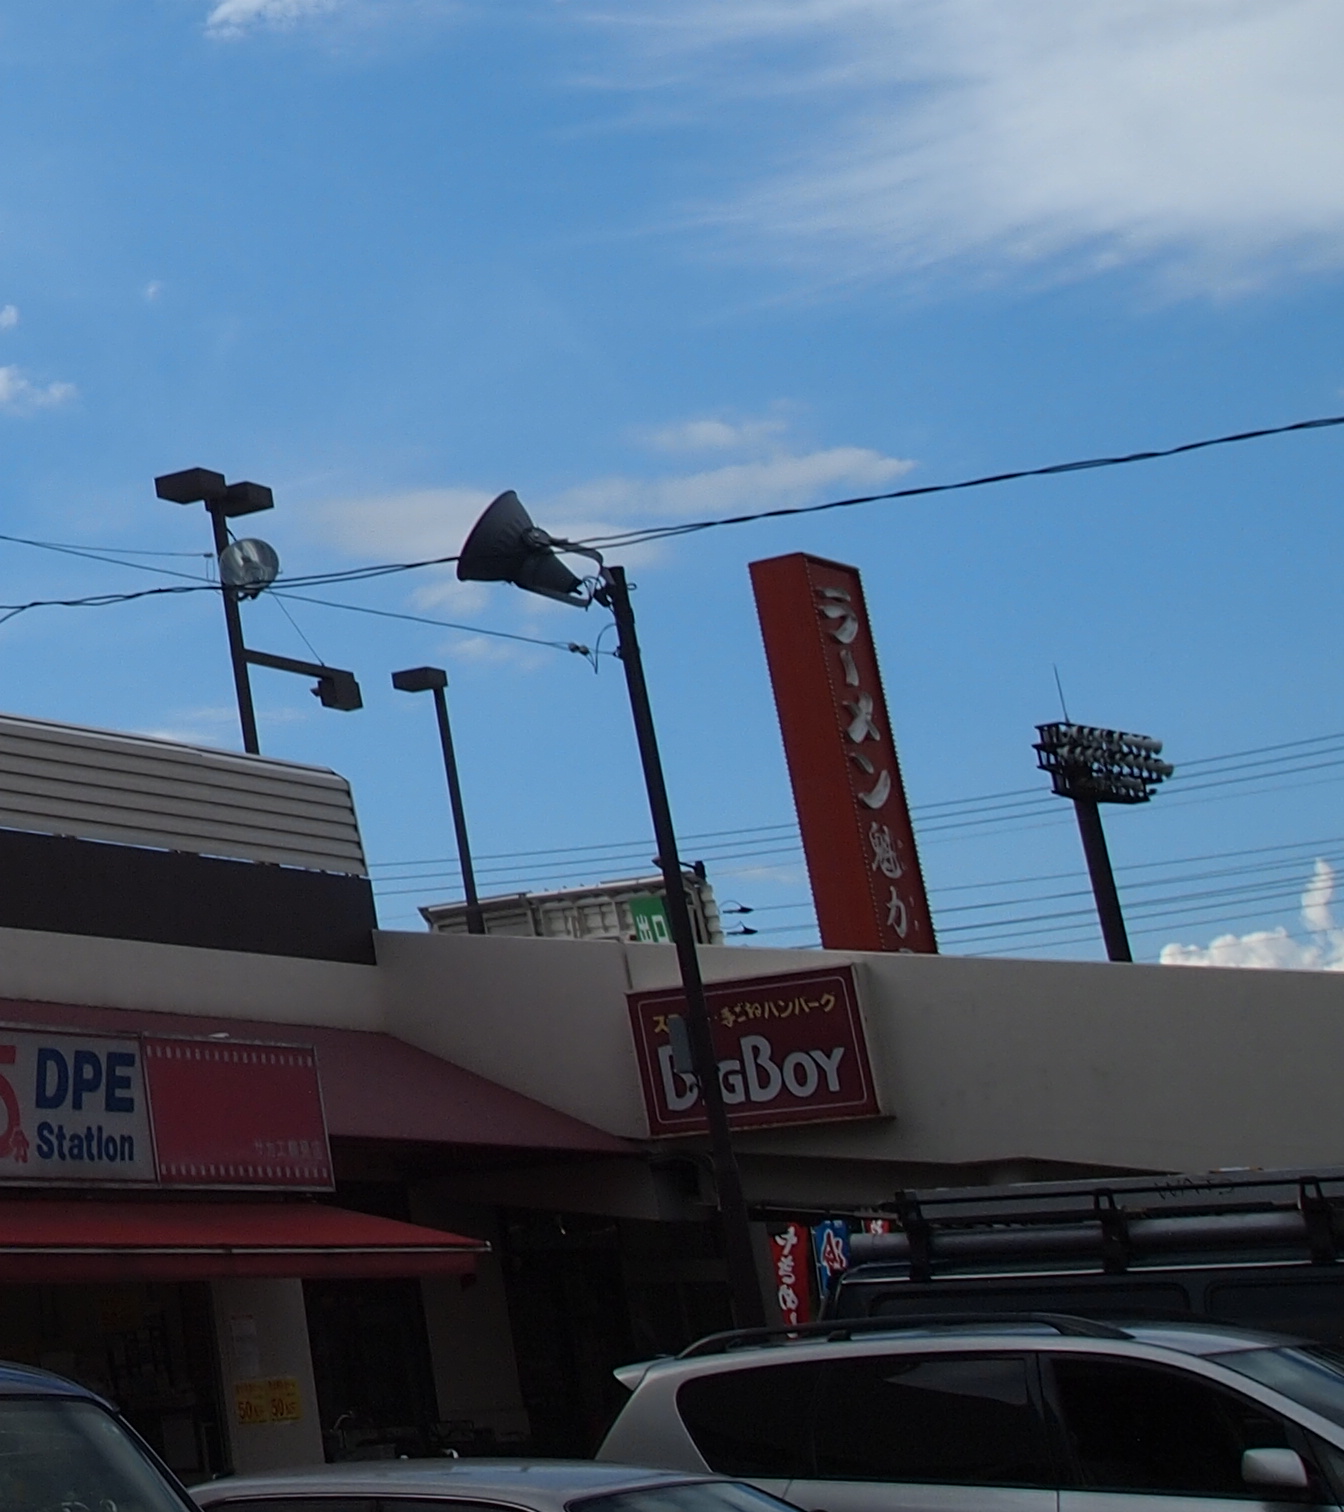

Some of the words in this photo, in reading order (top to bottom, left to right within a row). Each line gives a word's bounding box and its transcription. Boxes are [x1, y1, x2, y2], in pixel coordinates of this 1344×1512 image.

[34, 1046, 135, 1114] DPE
[657, 1035, 845, 1111] BGBOY
[35, 1122, 135, 1163] Station
